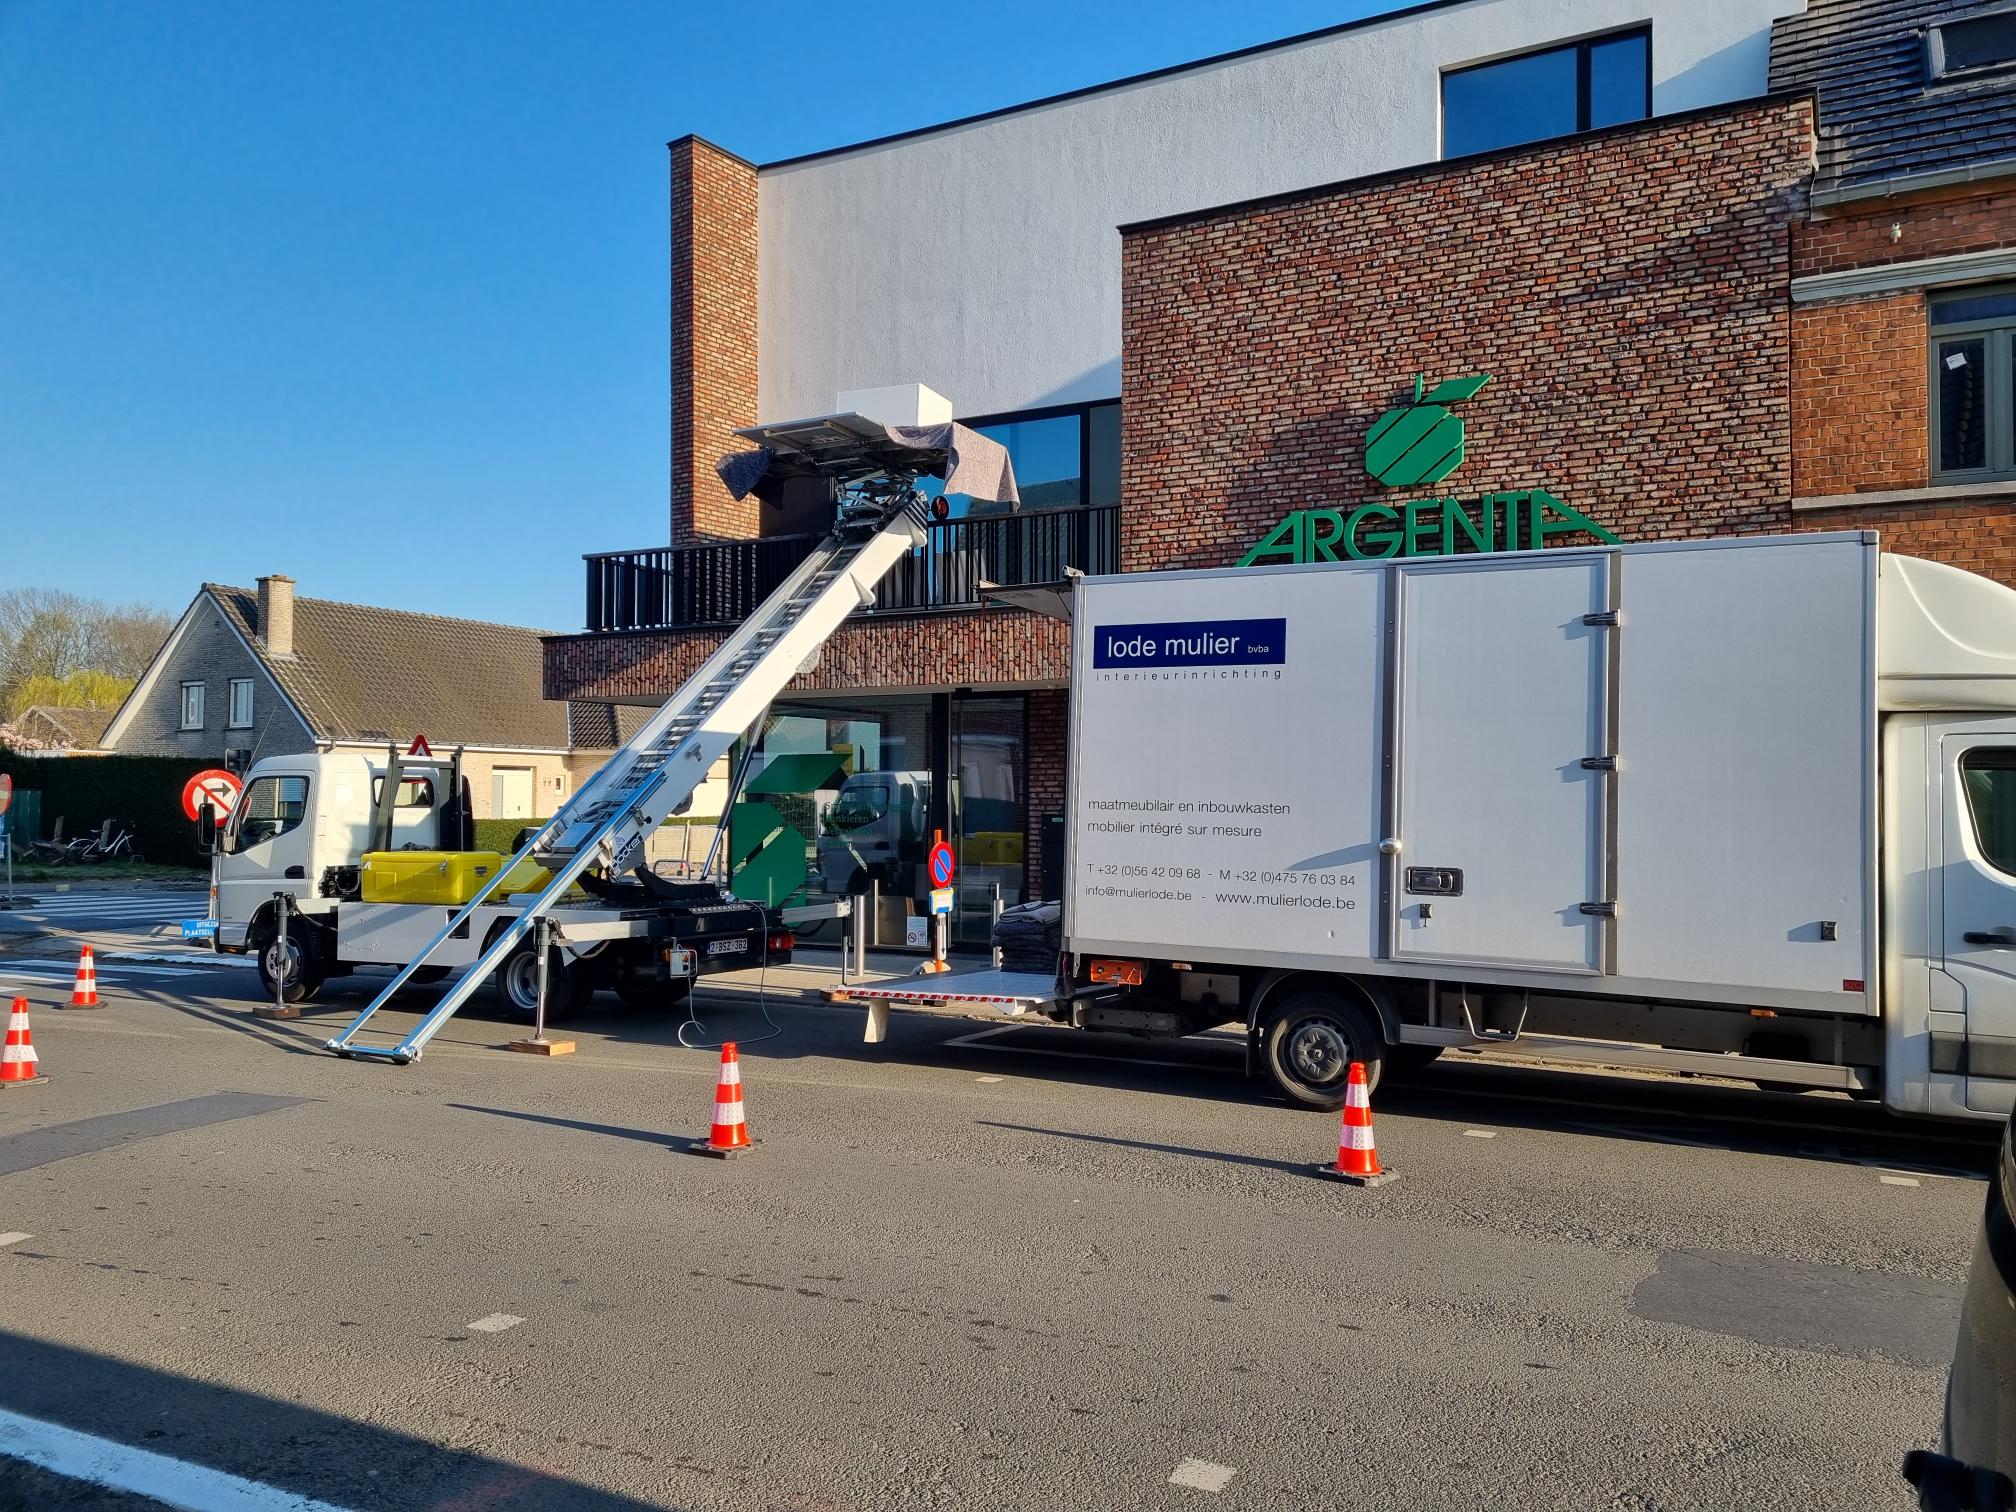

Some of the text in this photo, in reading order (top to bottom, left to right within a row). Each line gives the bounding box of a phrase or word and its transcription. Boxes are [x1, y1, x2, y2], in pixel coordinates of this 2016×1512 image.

[1232, 488, 1626, 567] ARGENTA
[1107, 632, 1270, 658] lode mulier bvba
[1095, 668, 1282, 682] interieurinrichting
[1087, 799, 1291, 815] maatmeubilair en inbouwkasten
[1087, 820, 1263, 837] mobilier intégré sur mesure
[1086, 863, 1095, 874] T
[1097, 864, 1118, 875] +32
[1121, 865, 1148, 878] (0)56
[1151, 866, 1166, 877] 42
[1168, 867, 1184, 878] 09
[1186, 868, 1201, 879] 68
[1219, 869, 1231, 880] M
[1234, 870, 1257, 882] +32
[1260, 871, 1298, 885] (0)475
[1301, 873, 1317, 885] 76
[1320, 873, 1336, 886] 03
[1339, 875, 1356, 886] 84
[1085, 885, 1192, 901] info@mulierlode.be
[1215, 892, 1356, 910] www.mulierlode.be
